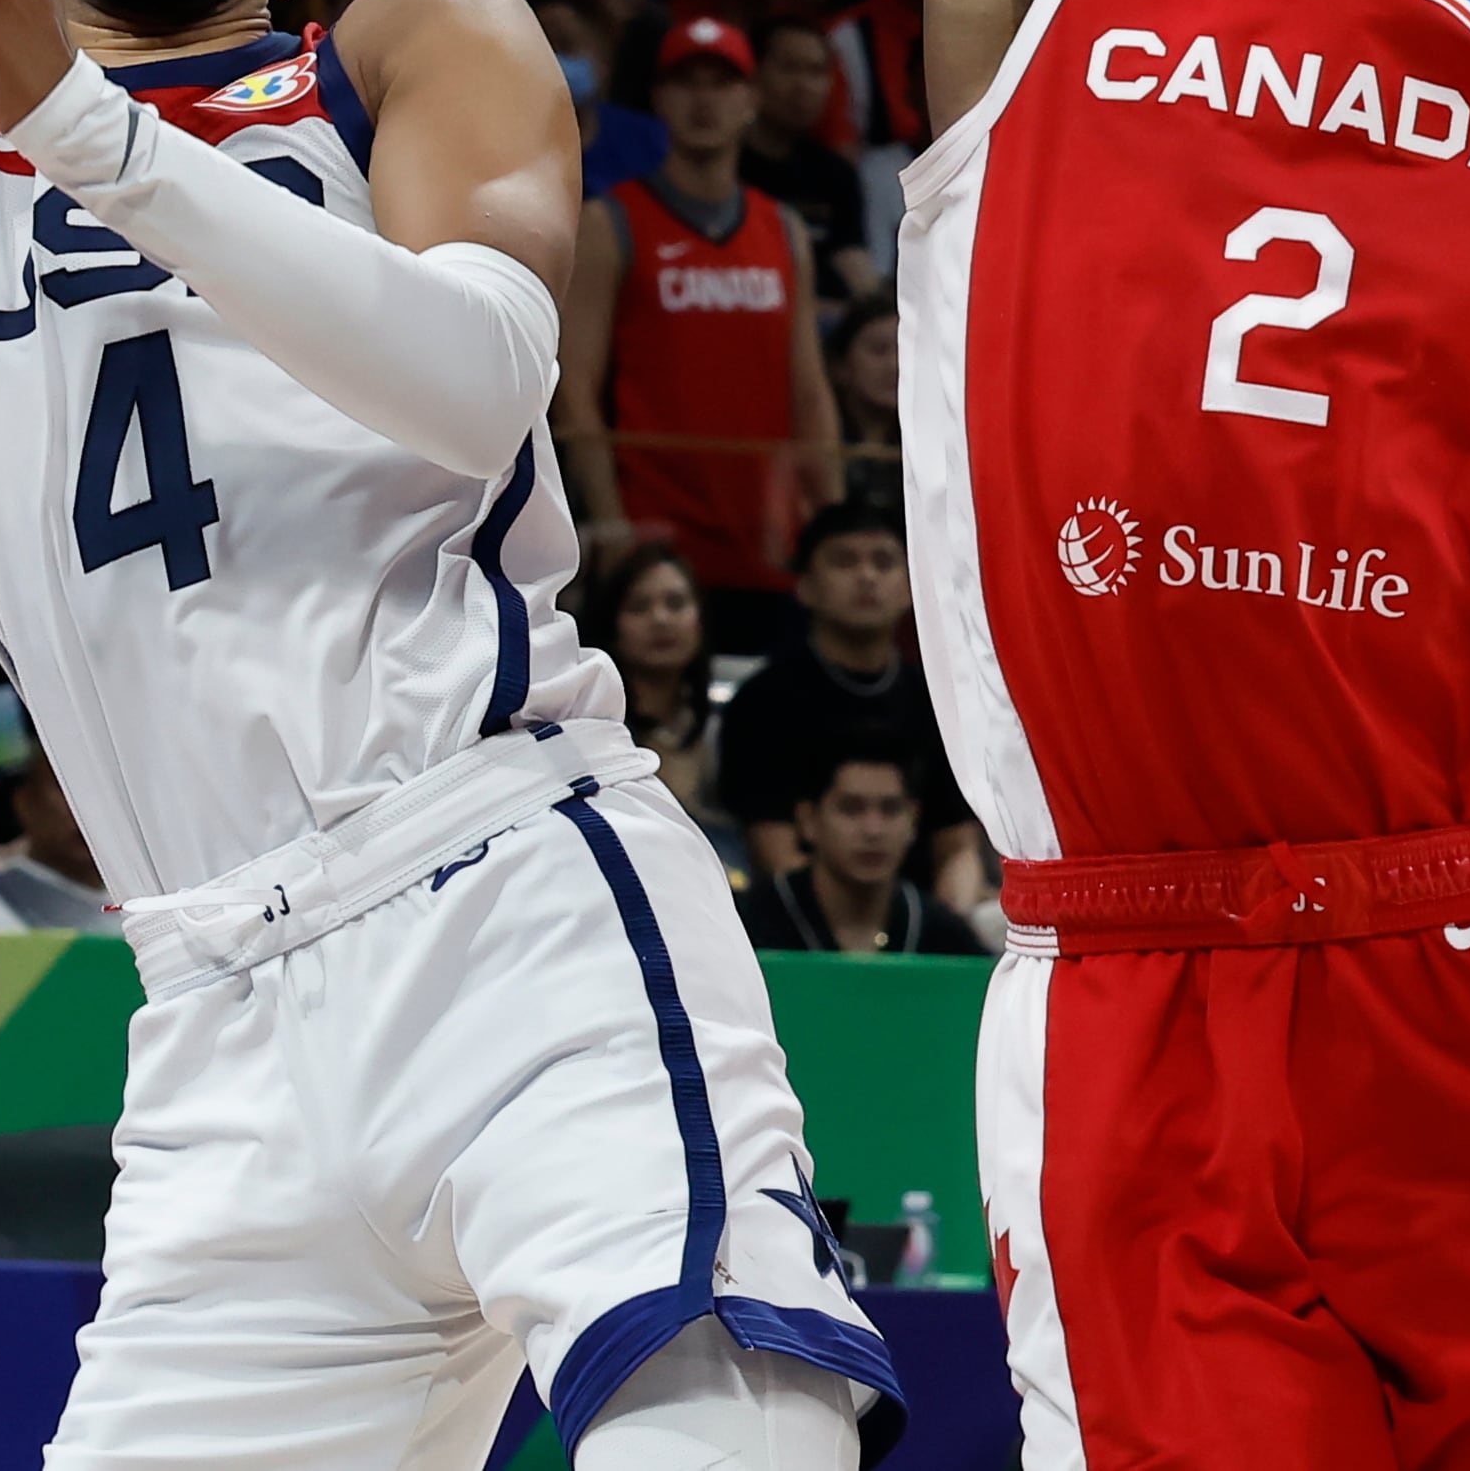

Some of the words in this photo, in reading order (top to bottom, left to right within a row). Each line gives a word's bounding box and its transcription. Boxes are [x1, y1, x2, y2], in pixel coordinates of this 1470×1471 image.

[1201, 206, 1355, 428] 2
[72, 329, 221, 592] 4
[1159, 524, 1285, 597] Sun
[1296, 541, 1410, 619] Life
